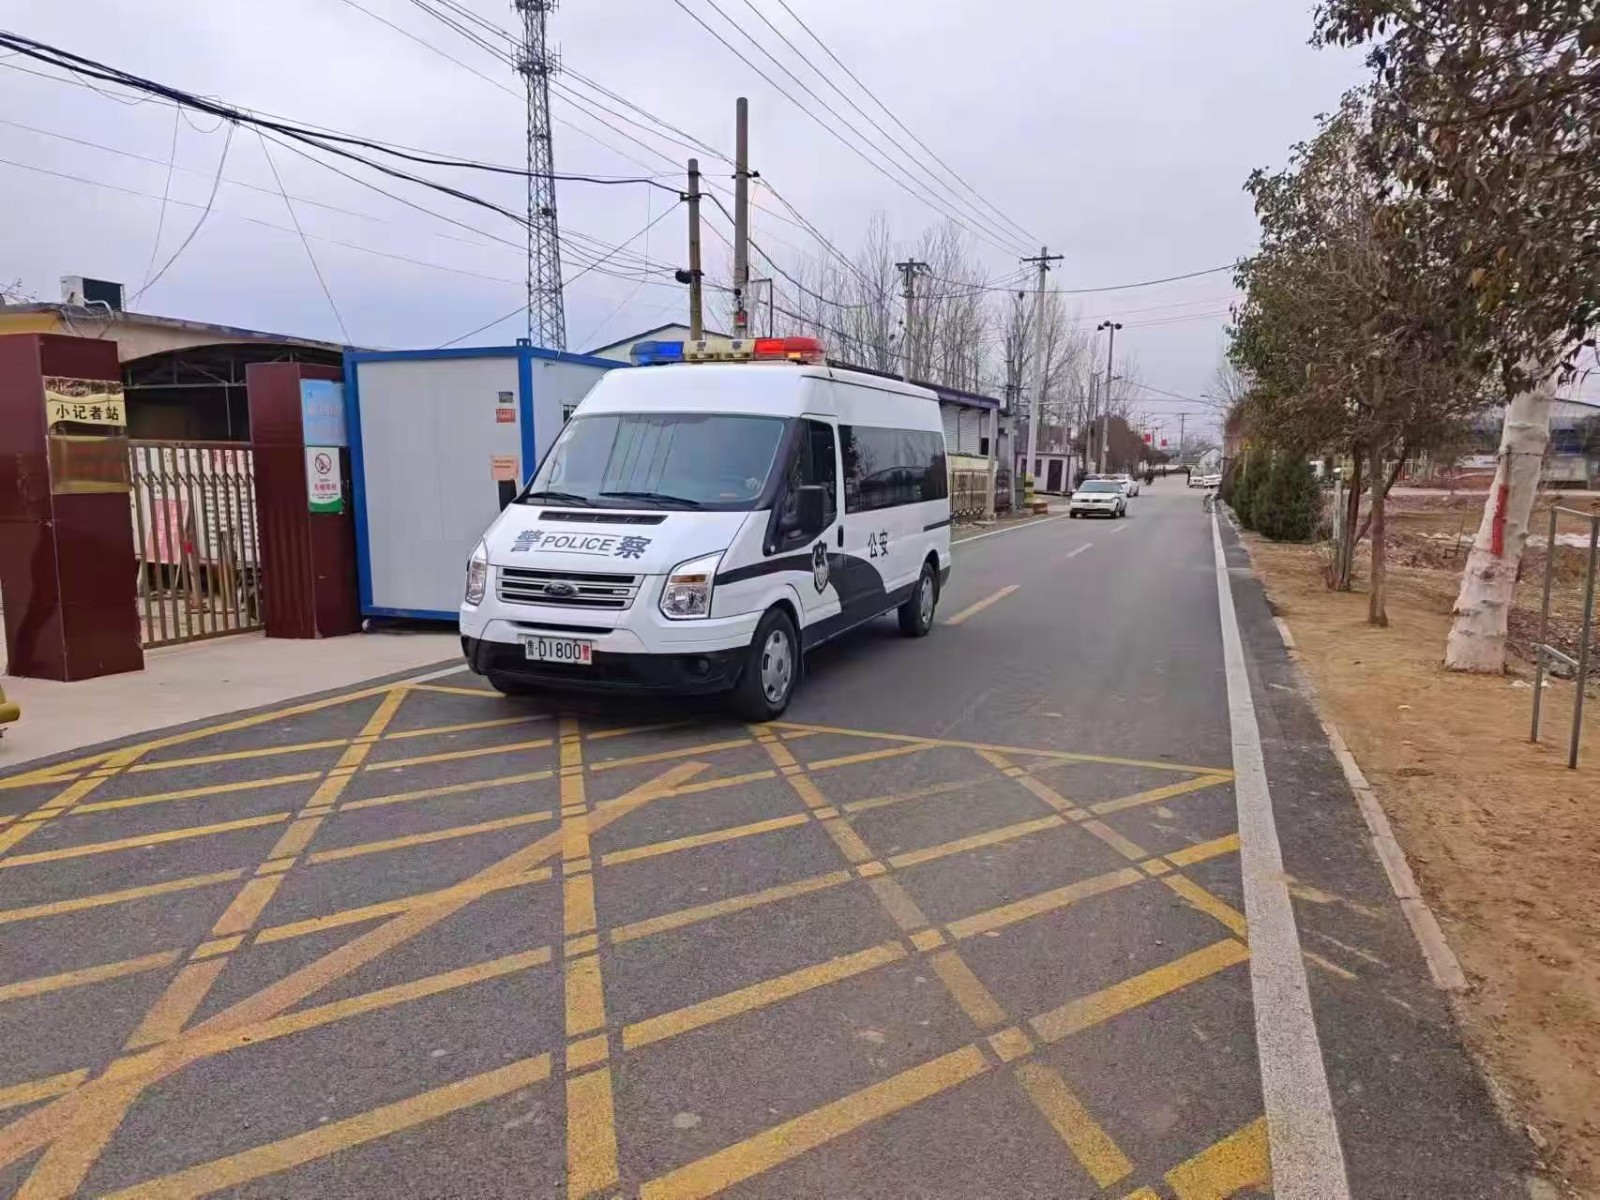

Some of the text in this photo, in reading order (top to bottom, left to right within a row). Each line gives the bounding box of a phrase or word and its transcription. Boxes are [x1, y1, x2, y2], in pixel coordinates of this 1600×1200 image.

[56, 404, 119, 421] 小记者站
[510, 530, 652, 559] 警 POLICE 察
[867, 529, 888, 558] 公安
